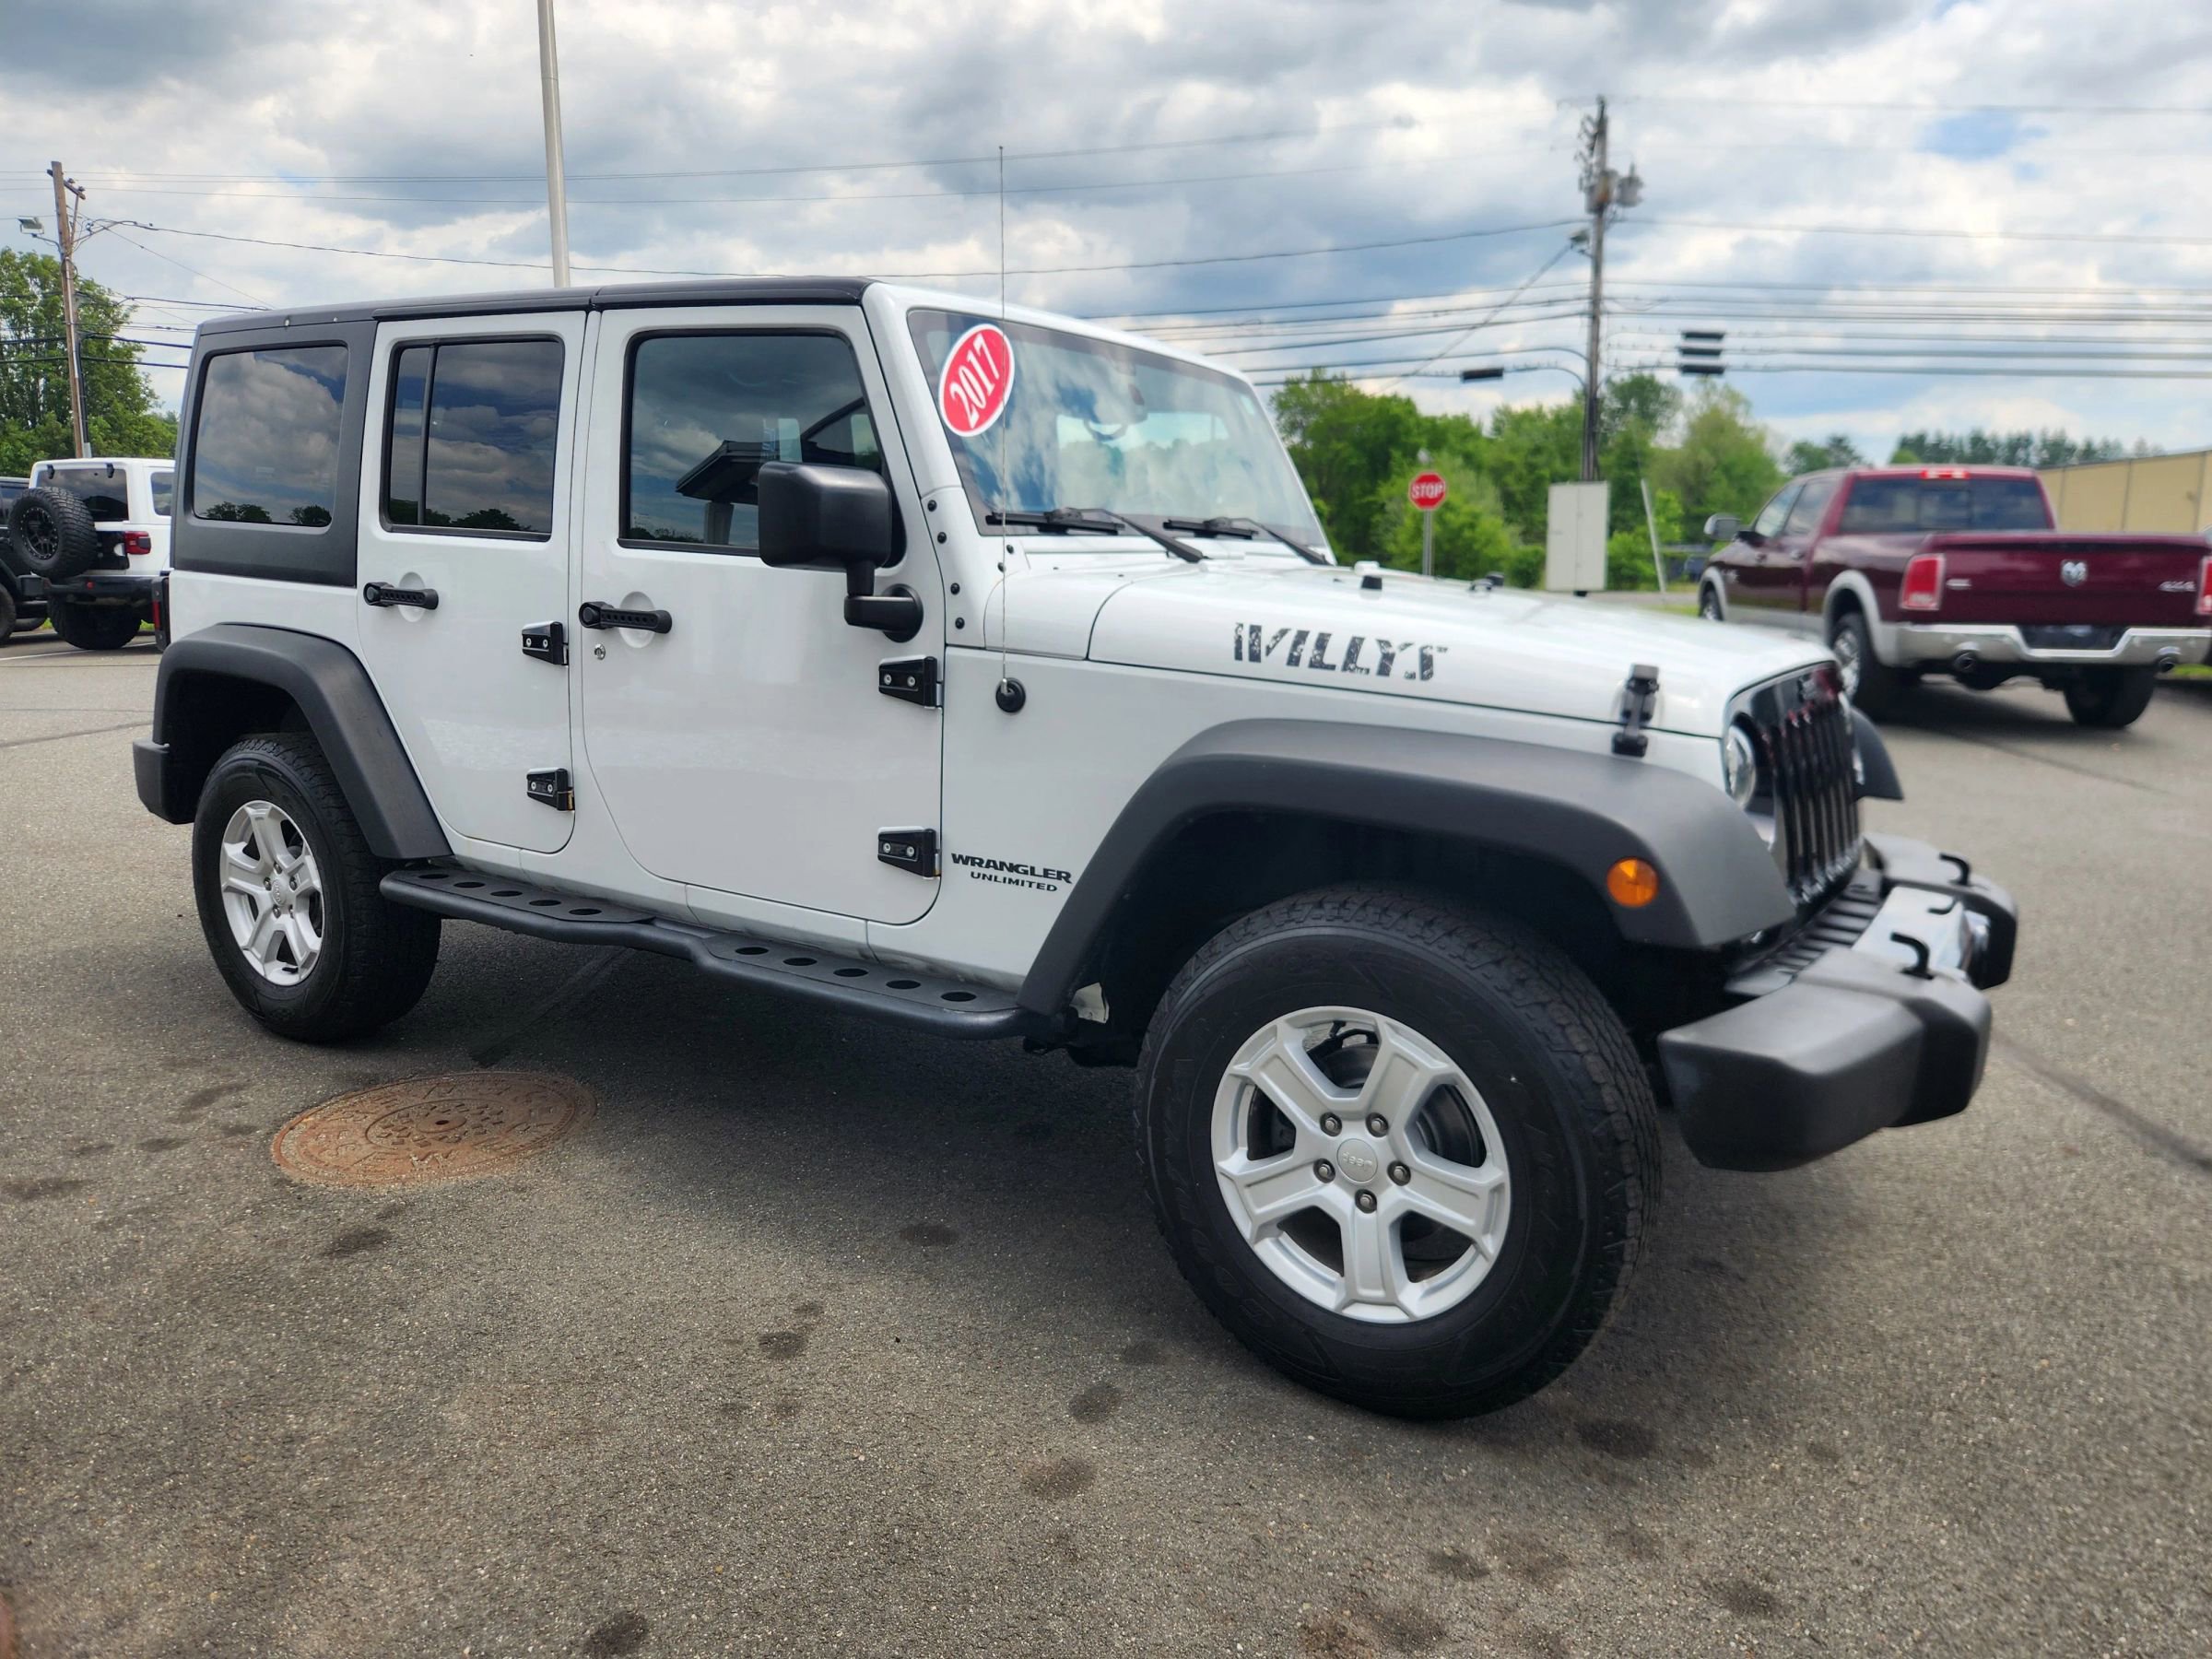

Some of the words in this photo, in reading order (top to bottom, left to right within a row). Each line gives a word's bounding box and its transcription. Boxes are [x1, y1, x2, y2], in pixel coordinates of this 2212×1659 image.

[948, 333, 1000, 429] 2017
[1411, 481, 1444, 499] STOP
[1233, 622, 1449, 682] WILLYS
[951, 853, 1072, 884] WRANGLER
[971, 871, 1058, 892] UNLIMITED
